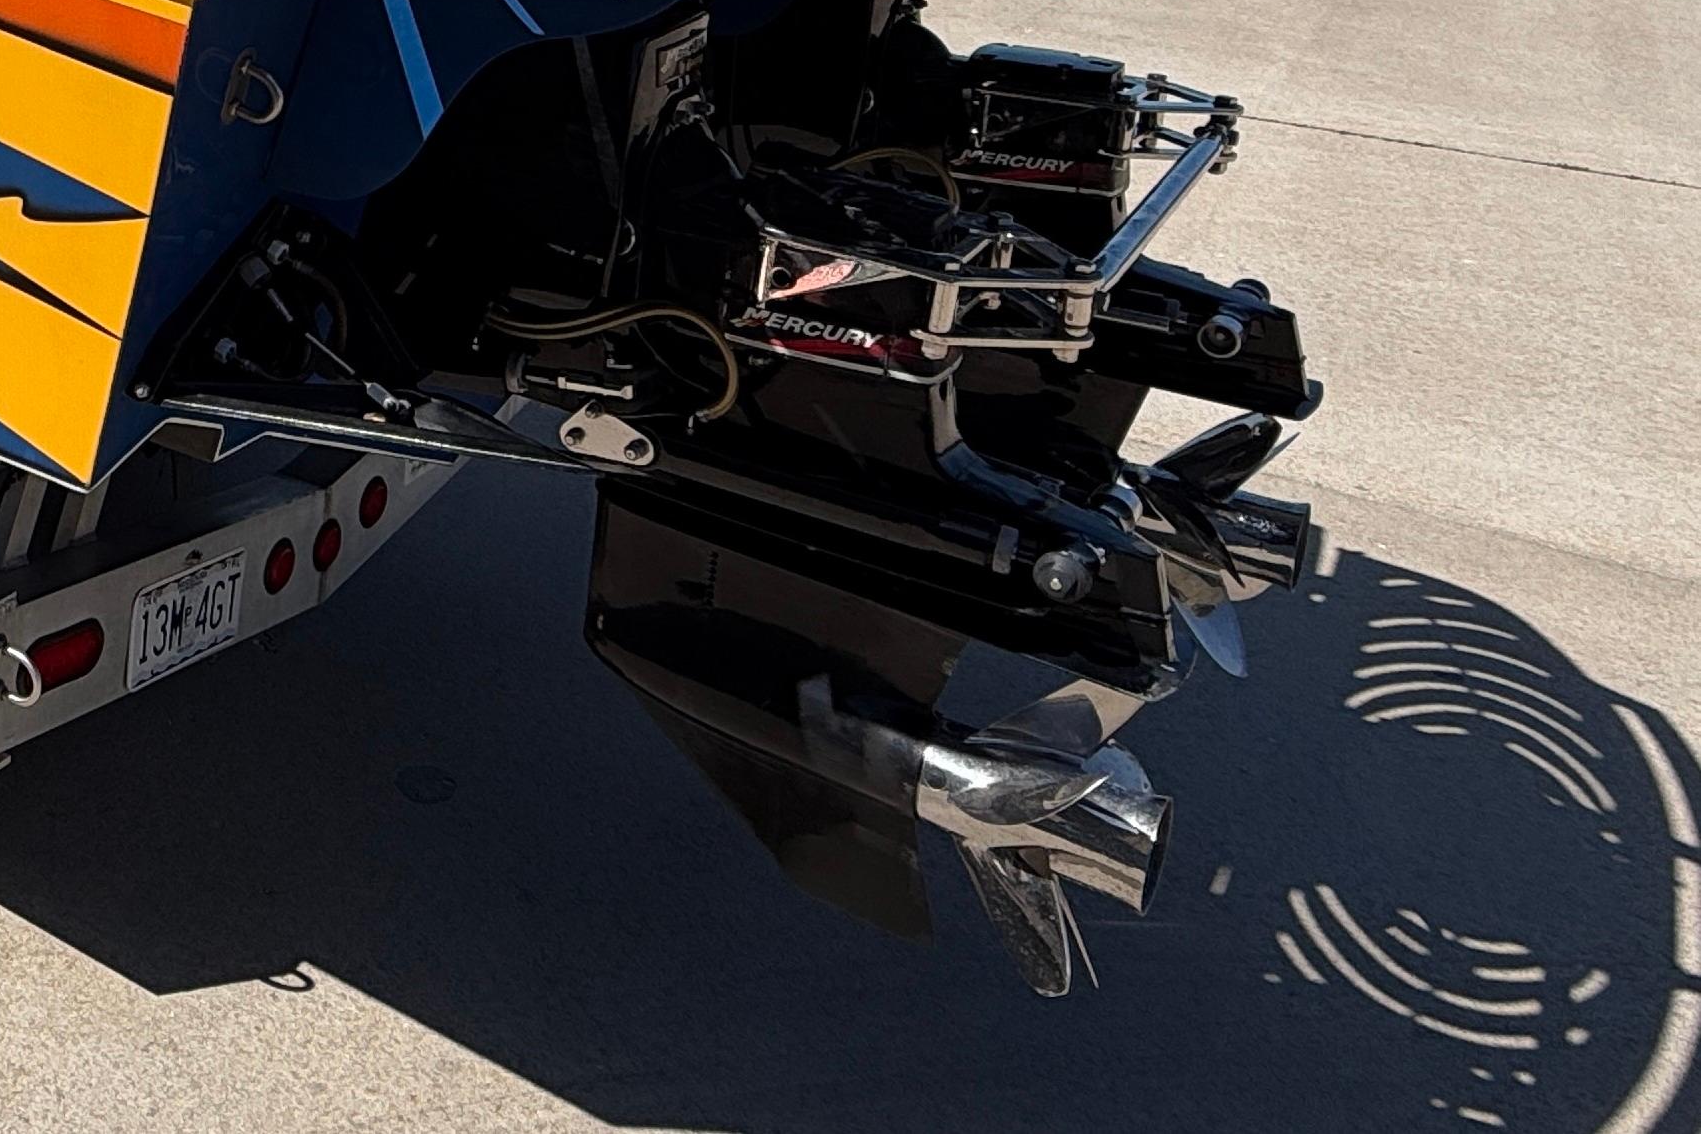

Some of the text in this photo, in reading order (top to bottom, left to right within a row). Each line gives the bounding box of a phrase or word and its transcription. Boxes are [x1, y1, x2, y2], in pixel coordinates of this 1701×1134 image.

[957, 149, 1075, 173] MERCURY
[742, 306, 884, 348] MERCURY
[138, 594, 186, 666] 13M
[194, 571, 242, 635] 4GT
